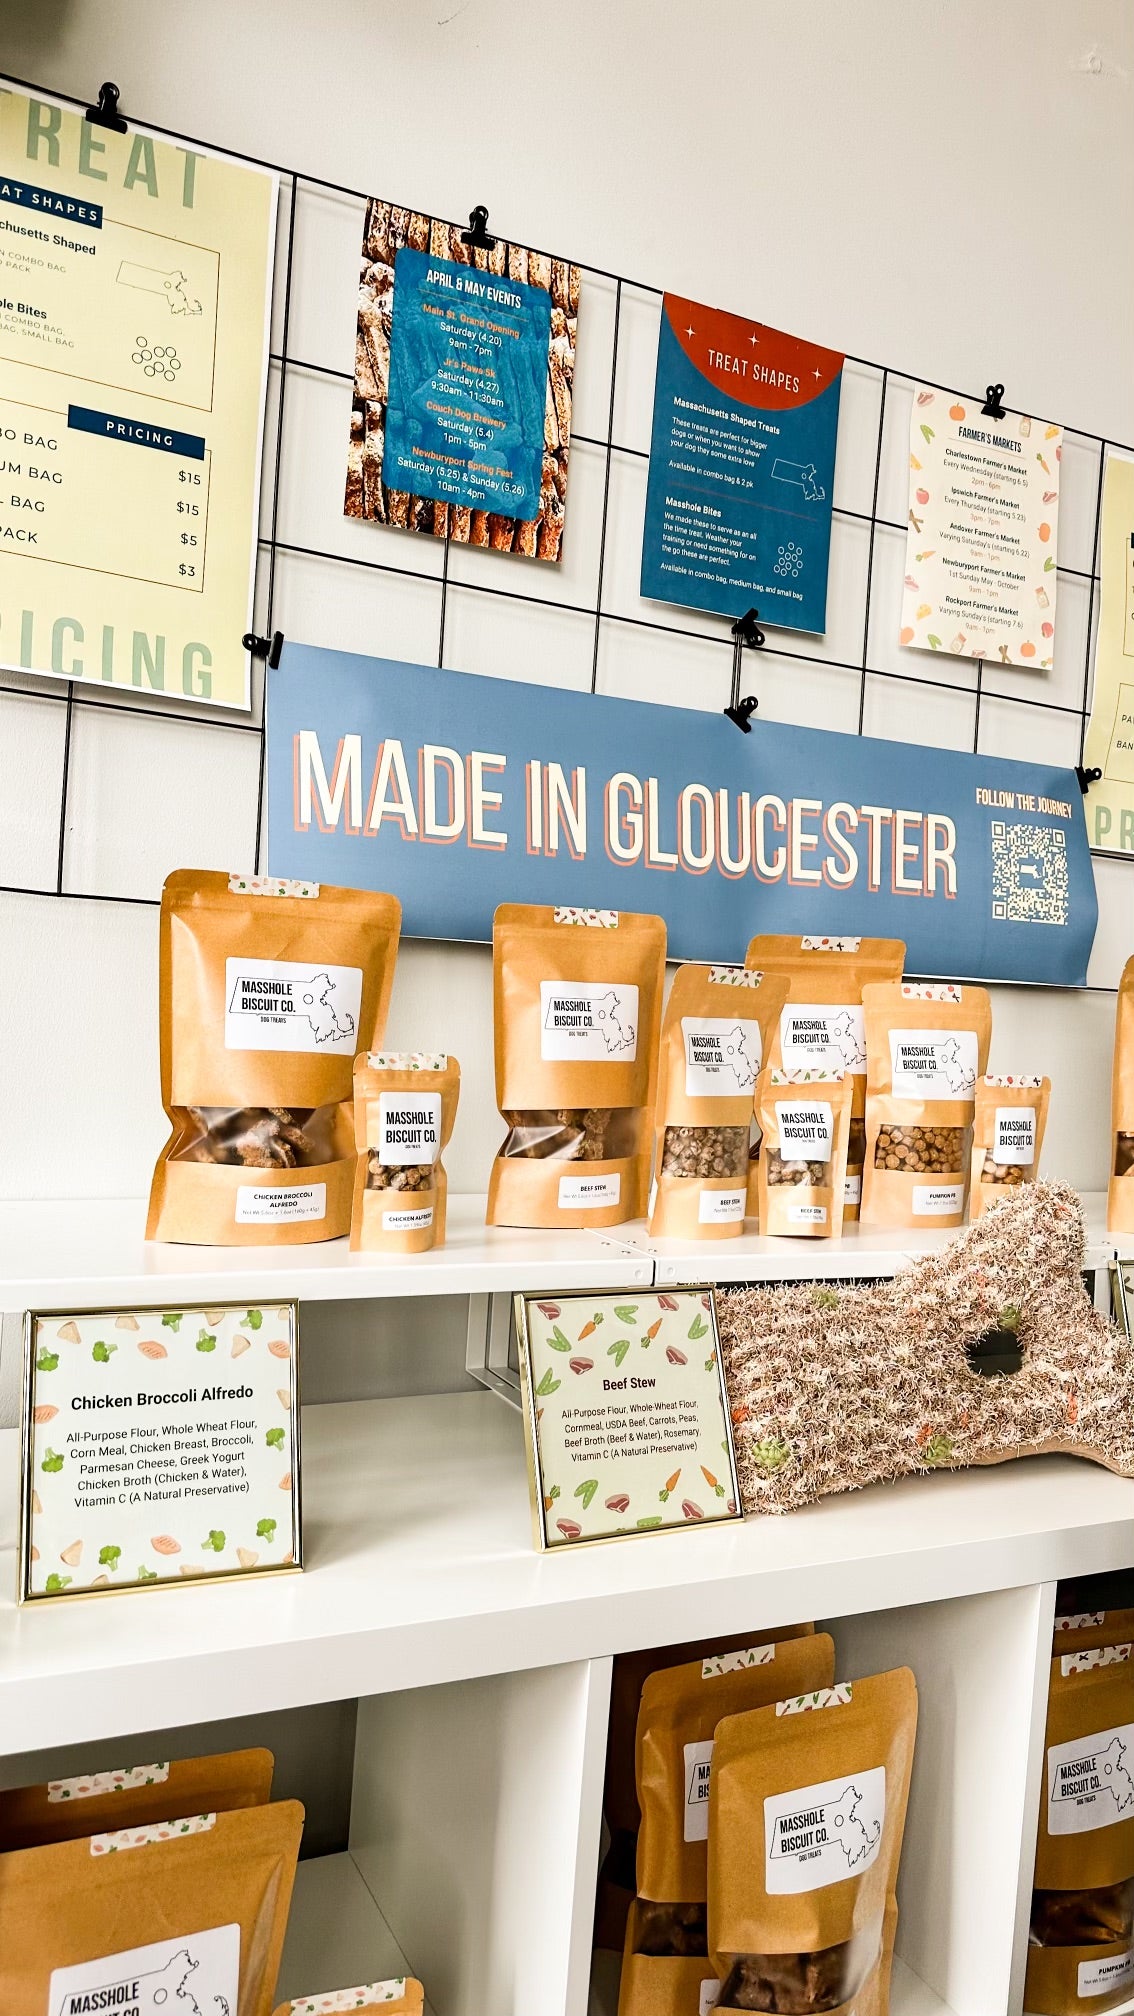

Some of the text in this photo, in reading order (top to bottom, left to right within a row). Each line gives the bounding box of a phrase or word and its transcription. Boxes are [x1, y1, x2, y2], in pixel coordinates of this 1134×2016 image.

[31, 192, 98, 221] SHAPES
[53, 235, 96, 255] Shaped
[426, 270, 521, 308] APRIL & MAY EVENTS
[17, 302, 47, 319] Bites
[423, 304, 520, 339] Main St. Grand Opening
[440, 322, 502, 347] Saturday (4.20)
[449, 338, 492, 356] 9am 7pm
[708, 349, 800, 393] TREAT SHAPES
[438, 369, 499, 394] Saturday (4.27)
[431, 381, 504, 407] 9:30am 11:30am
[426, 401, 506, 430] Couch Dog Brewery
[673, 397, 780, 435] Massachusetts Shaped Treats
[106, 420, 173, 446] PRICING
[437, 417, 494, 440] Saturday (5.4)
[24, 433, 58, 450] BAG
[444, 433, 486, 450] 1pm 5pm
[959, 426, 1021, 453] FARMER'S MARKETS
[412, 447, 513, 478] Newburyport Spring Fest
[946, 448, 1027, 475] Charlestown Farmer's Market
[28, 466, 63, 484] BAG
[178, 470, 201, 485] $15
[398, 457, 525, 496] Saturday (5.25) & Sunday (5.26)
[438, 481, 485, 500] 10am 4pm
[952, 487, 1020, 509] Ipswich Farmer's Market
[11, 496, 45, 512] BAG
[177, 501, 199, 516] $15
[665, 497, 721, 518] Masshole Bites
[181, 533, 197, 546] $5
[178, 564, 195, 577] $3
[976, 787, 1072, 818] FOLLOW THE JOURNEY
[293, 730, 957, 899] MADE IN GLOUCESTER
[242, 981, 292, 995] MASSHOLE
[242, 998, 296, 1012] BISCUIT CO.
[554, 1001, 591, 1012] MASSHOLE
[555, 1016, 594, 1026] BISCUIT CO.
[793, 1021, 827, 1030] MASSHOLE
[793, 1034, 830, 1043] BISCUIT CO.
[902, 1047, 934, 1056] MASSHOLE
[903, 1060, 938, 1070] BISCUIT CO.
[386, 1112, 434, 1124] MASSHOLE
[782, 1113, 825, 1123] MASSHOLE
[1000, 1121, 1032, 1131] MASSHOLE
[386, 1130, 436, 1143] BISCUIT CO.
[784, 1128, 829, 1138] BISCUIT CO.
[1000, 1135, 1025, 1145] BISCUIT
[603, 1378, 656, 1390] Beef Stew
[71, 1385, 253, 1410] Chicken Broccoli Alfredo
[562, 1400, 698, 1418] All-Purpose Flour, Whole-Wheat Flour,
[67, 1419, 258, 1443] All-Purpose Flour, Whole Wheat Flour,
[565, 1414, 698, 1433] Cornmeal, USDA Beef, Carrots, Peas,
[70, 1435, 254, 1458] Corn Meal, Chicken Breast, Broccoli,
[565, 1438, 582, 1448] Beef
[585, 1436, 605, 1445] Broth
[607, 1433, 626, 1445] (Beef
[636, 1431, 662, 1440] Water),
[664, 1428, 701, 1438] Rosemary,
[571, 1442, 697, 1462] Vitamin C (A Natural Preservative)
[81, 1452, 245, 1474] Parmesan Cheese, Greek Yogurt
[78, 1466, 247, 1491] Chicken Broth (Chicken & Water),
[75, 1481, 249, 1507] Vitamin C (A Natural Preservative)
[1061, 1758, 1097, 1779] MASSHOLE
[1061, 1776, 1101, 1796] BISCUIT CO.
[780, 1809, 825, 1834] MASSHOLE
[781, 1829, 829, 1853] BISCUIT CO.
[70, 1981, 139, 2014] MASSHOLE
